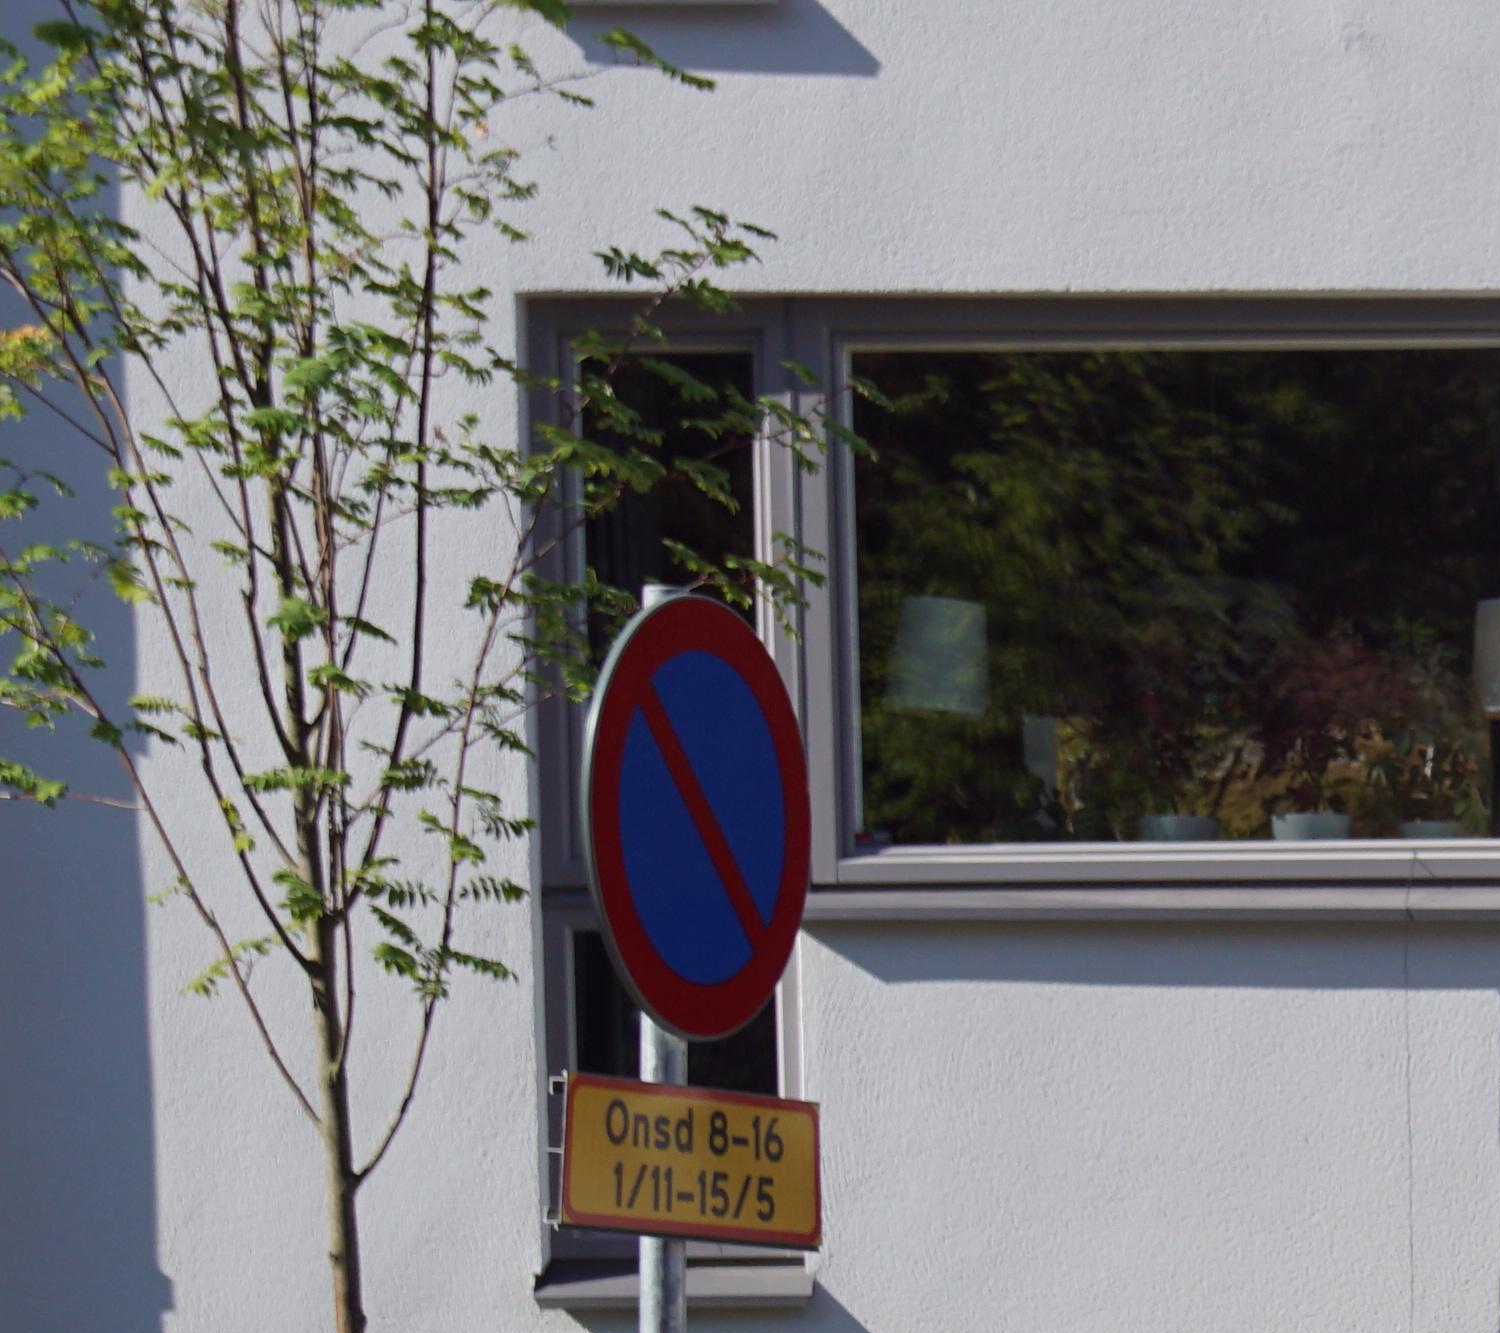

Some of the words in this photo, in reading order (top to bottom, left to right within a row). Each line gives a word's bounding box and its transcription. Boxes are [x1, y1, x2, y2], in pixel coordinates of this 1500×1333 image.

[605, 1097, 694, 1152] Onsd
[708, 1110, 784, 1162] 8-16
[613, 1161, 775, 1222] 1/11-15/5
